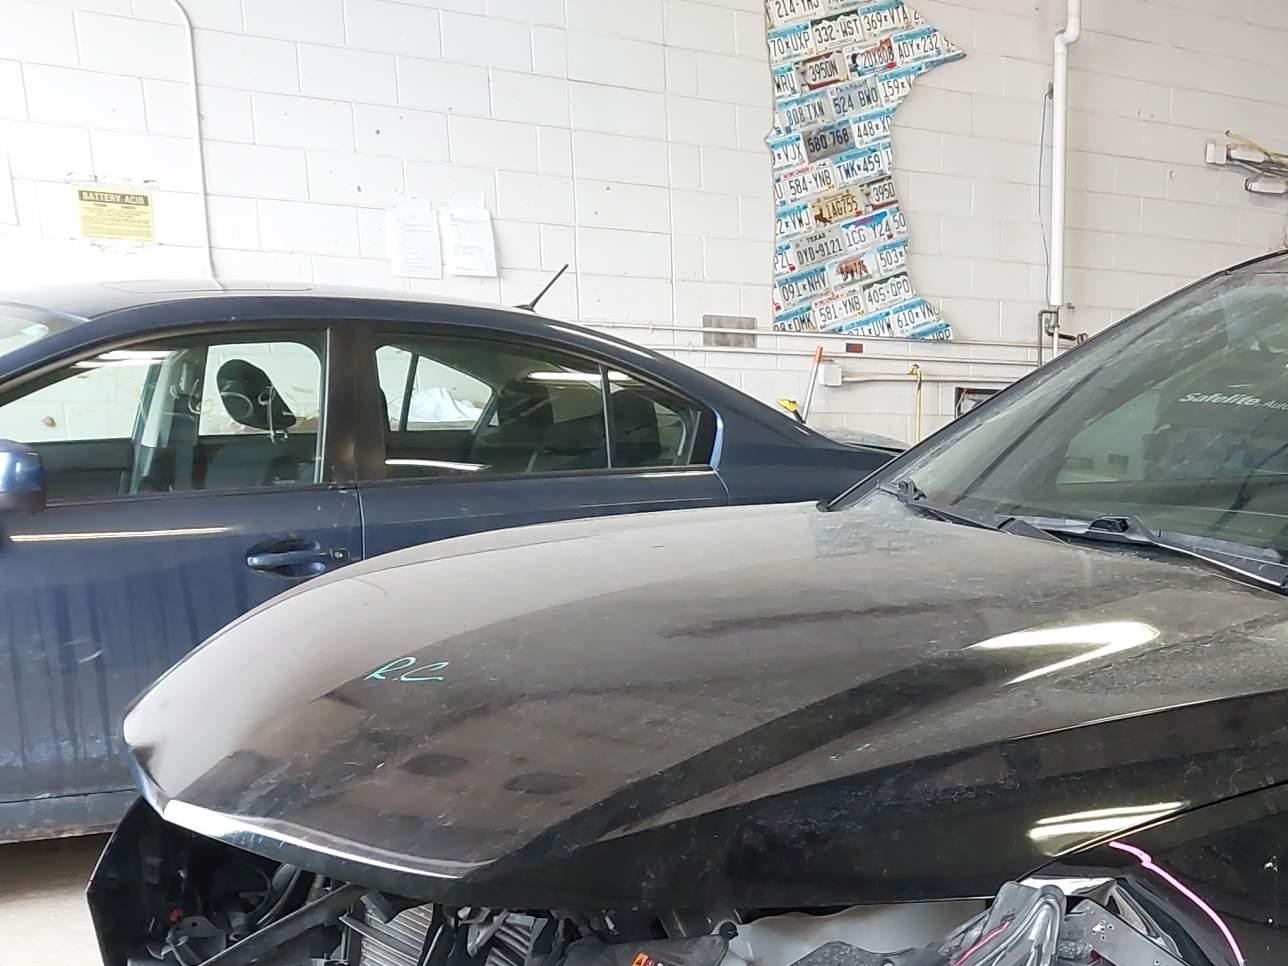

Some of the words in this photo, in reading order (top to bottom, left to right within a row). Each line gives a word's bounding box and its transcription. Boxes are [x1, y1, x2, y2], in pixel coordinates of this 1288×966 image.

[832, 94, 855, 115] 524
[829, 128, 849, 147] 768
[862, 153, 881, 173] 459
[82, 191, 121, 202] BATTERY
[124, 195, 144, 204] ACID
[806, 232, 826, 244] TEXAS
[1179, 392, 1262, 406] Safelite
